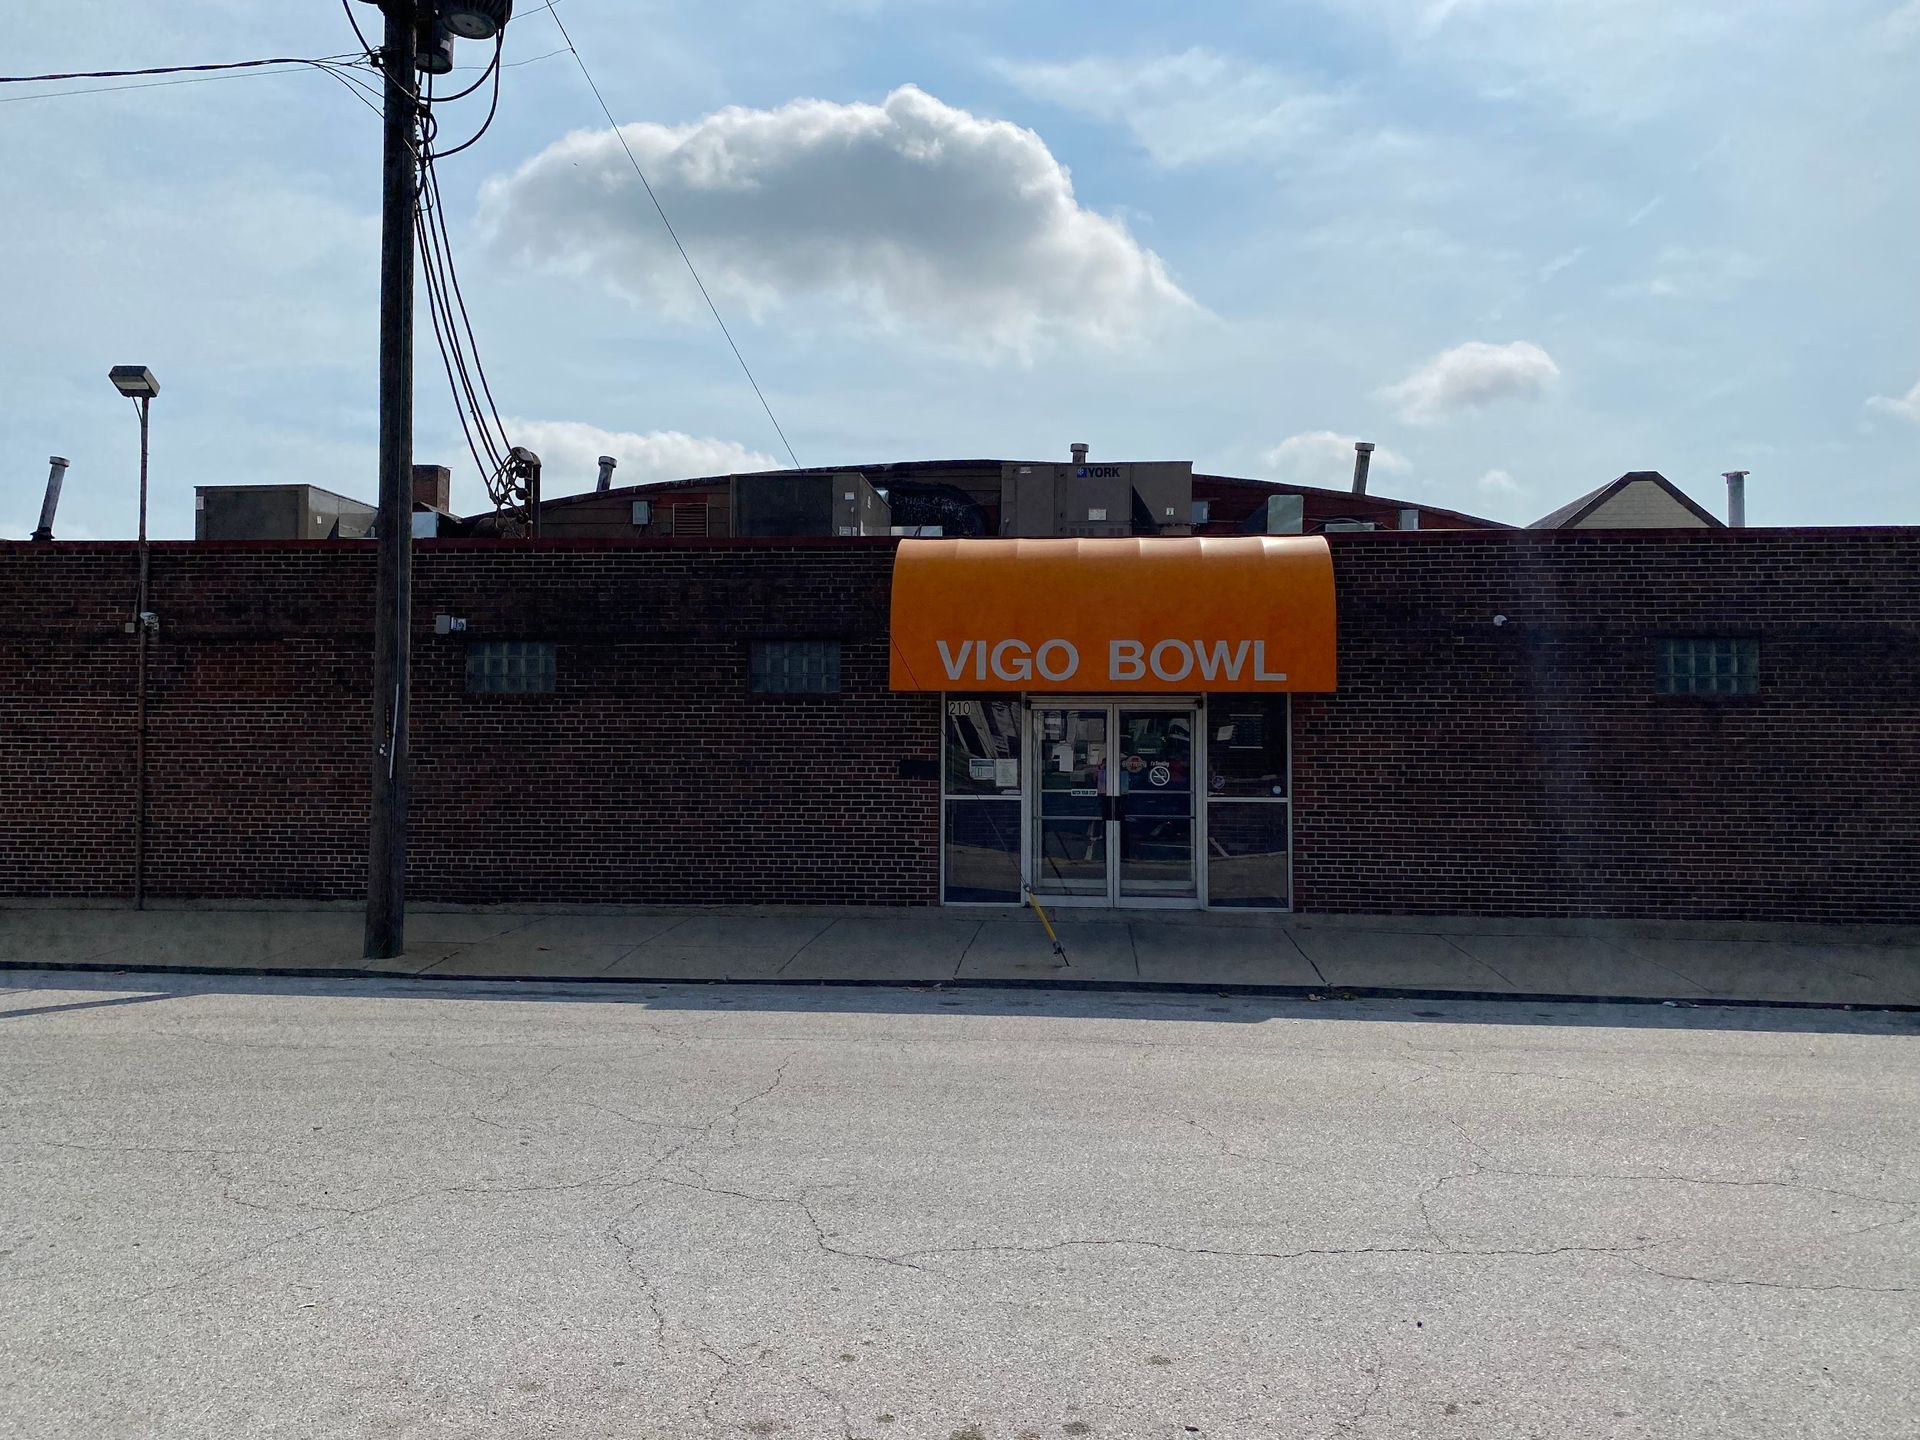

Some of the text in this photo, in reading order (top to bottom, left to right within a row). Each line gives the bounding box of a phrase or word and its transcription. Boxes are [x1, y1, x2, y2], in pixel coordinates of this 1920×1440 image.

[1088, 467, 1120, 478] YORK
[935, 639, 1288, 682] VIGO BOWL
[949, 702, 971, 715] 210
